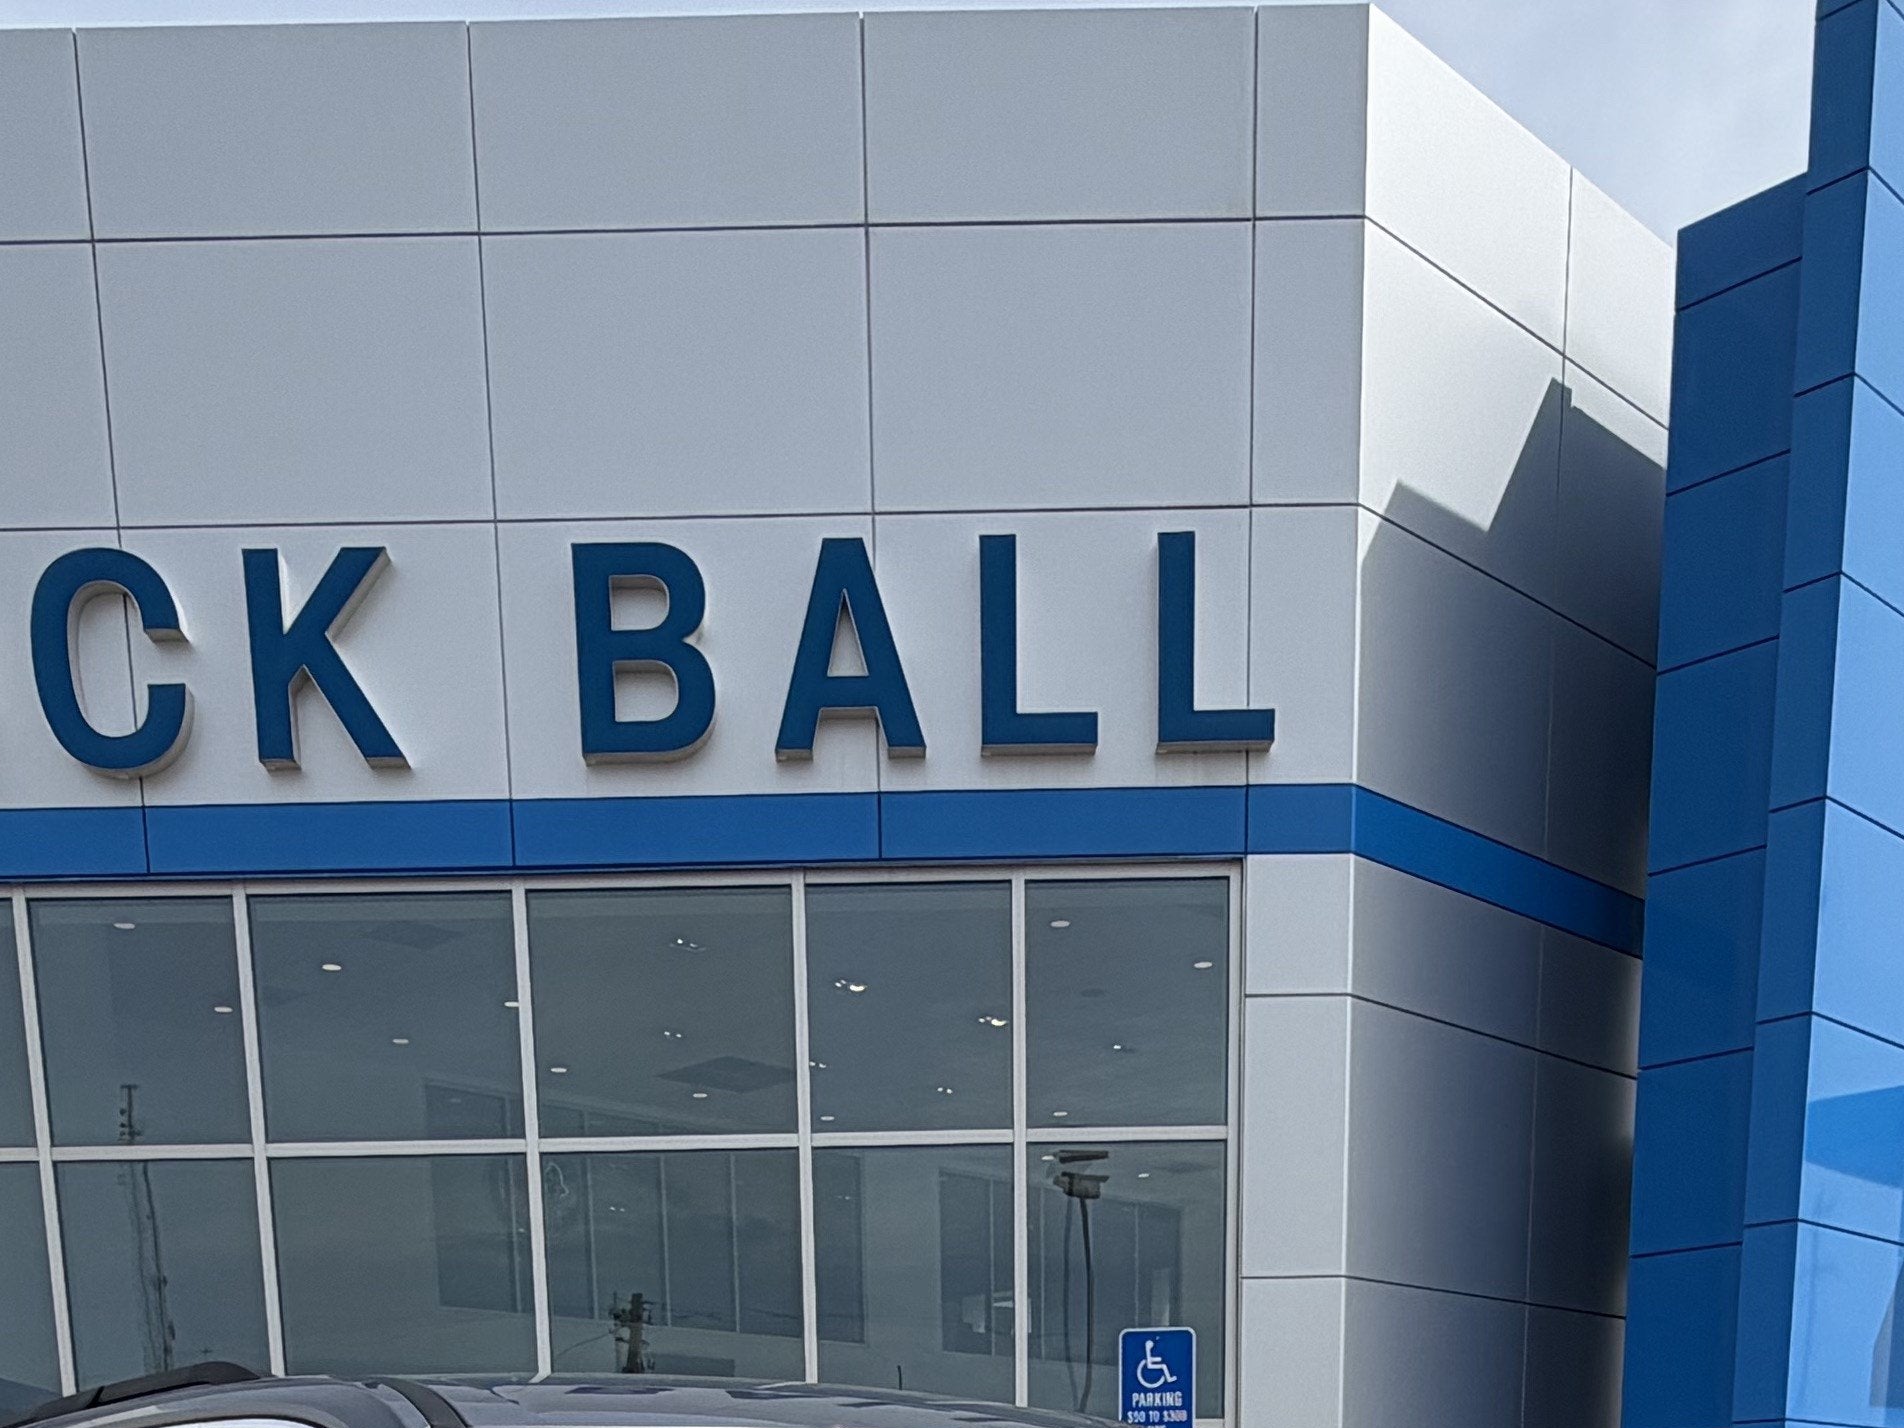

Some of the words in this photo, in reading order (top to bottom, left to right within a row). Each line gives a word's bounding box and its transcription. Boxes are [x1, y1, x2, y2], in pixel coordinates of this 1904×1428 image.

[570, 530, 1276, 764] BALL
[1132, 1391, 1183, 1408] PARKING
[1148, 1410, 1161, 1423] TO
